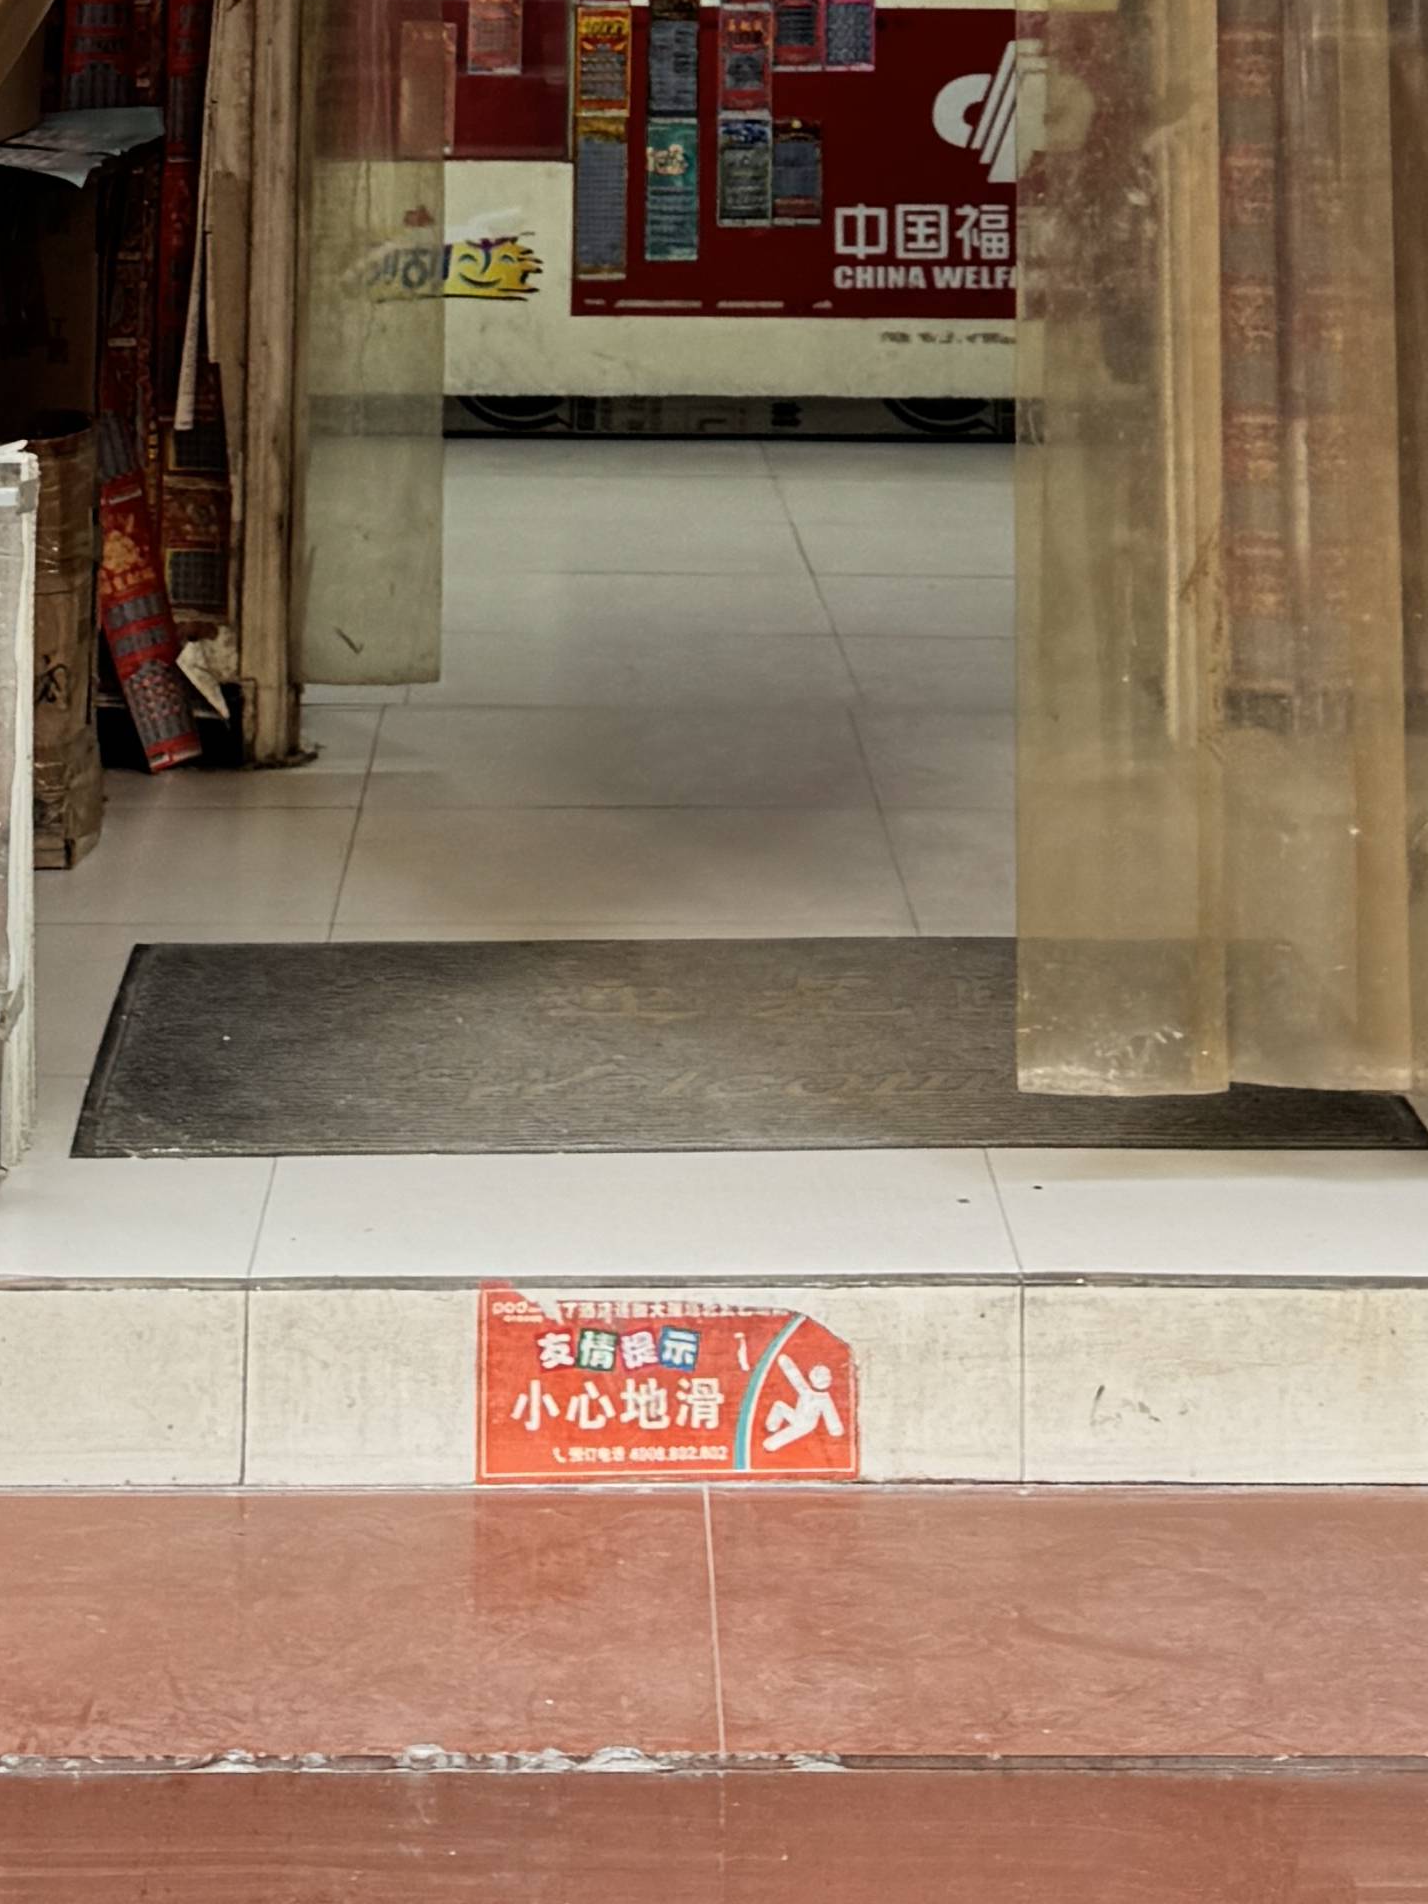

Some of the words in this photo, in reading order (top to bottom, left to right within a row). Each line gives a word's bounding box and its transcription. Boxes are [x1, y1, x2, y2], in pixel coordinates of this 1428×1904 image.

[832, 264, 927, 290] CHINA
[537, 1326, 700, 1370] 友情提示
[510, 1376, 726, 1432] 小心地滑
